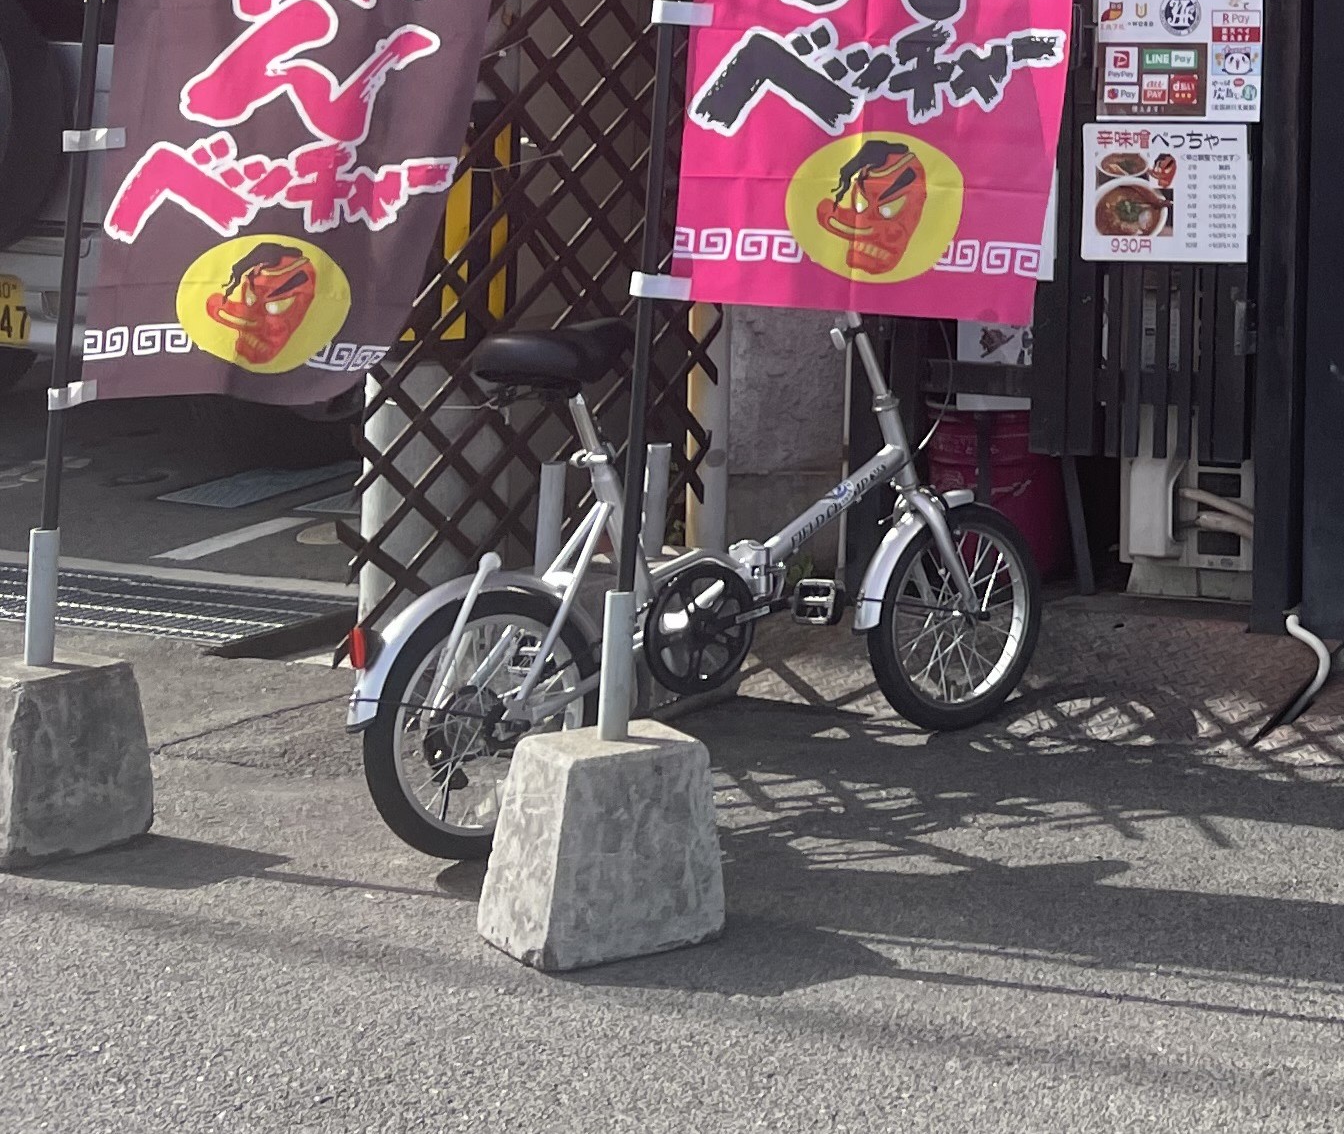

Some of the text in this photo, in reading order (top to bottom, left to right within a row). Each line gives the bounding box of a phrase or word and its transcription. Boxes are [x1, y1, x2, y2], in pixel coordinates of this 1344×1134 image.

[1231, 13, 1250, 26] Pay
[1145, 53, 1193, 65] LINE Pay
[688, 22, 1066, 136] ベッチャー
[1107, 70, 1135, 79] PayPay
[1120, 87, 1137, 100] Pay
[1146, 89, 1163, 99] PAY
[104, 131, 457, 243] ベッチャー
[1110, 238, 1152, 254] 930円
